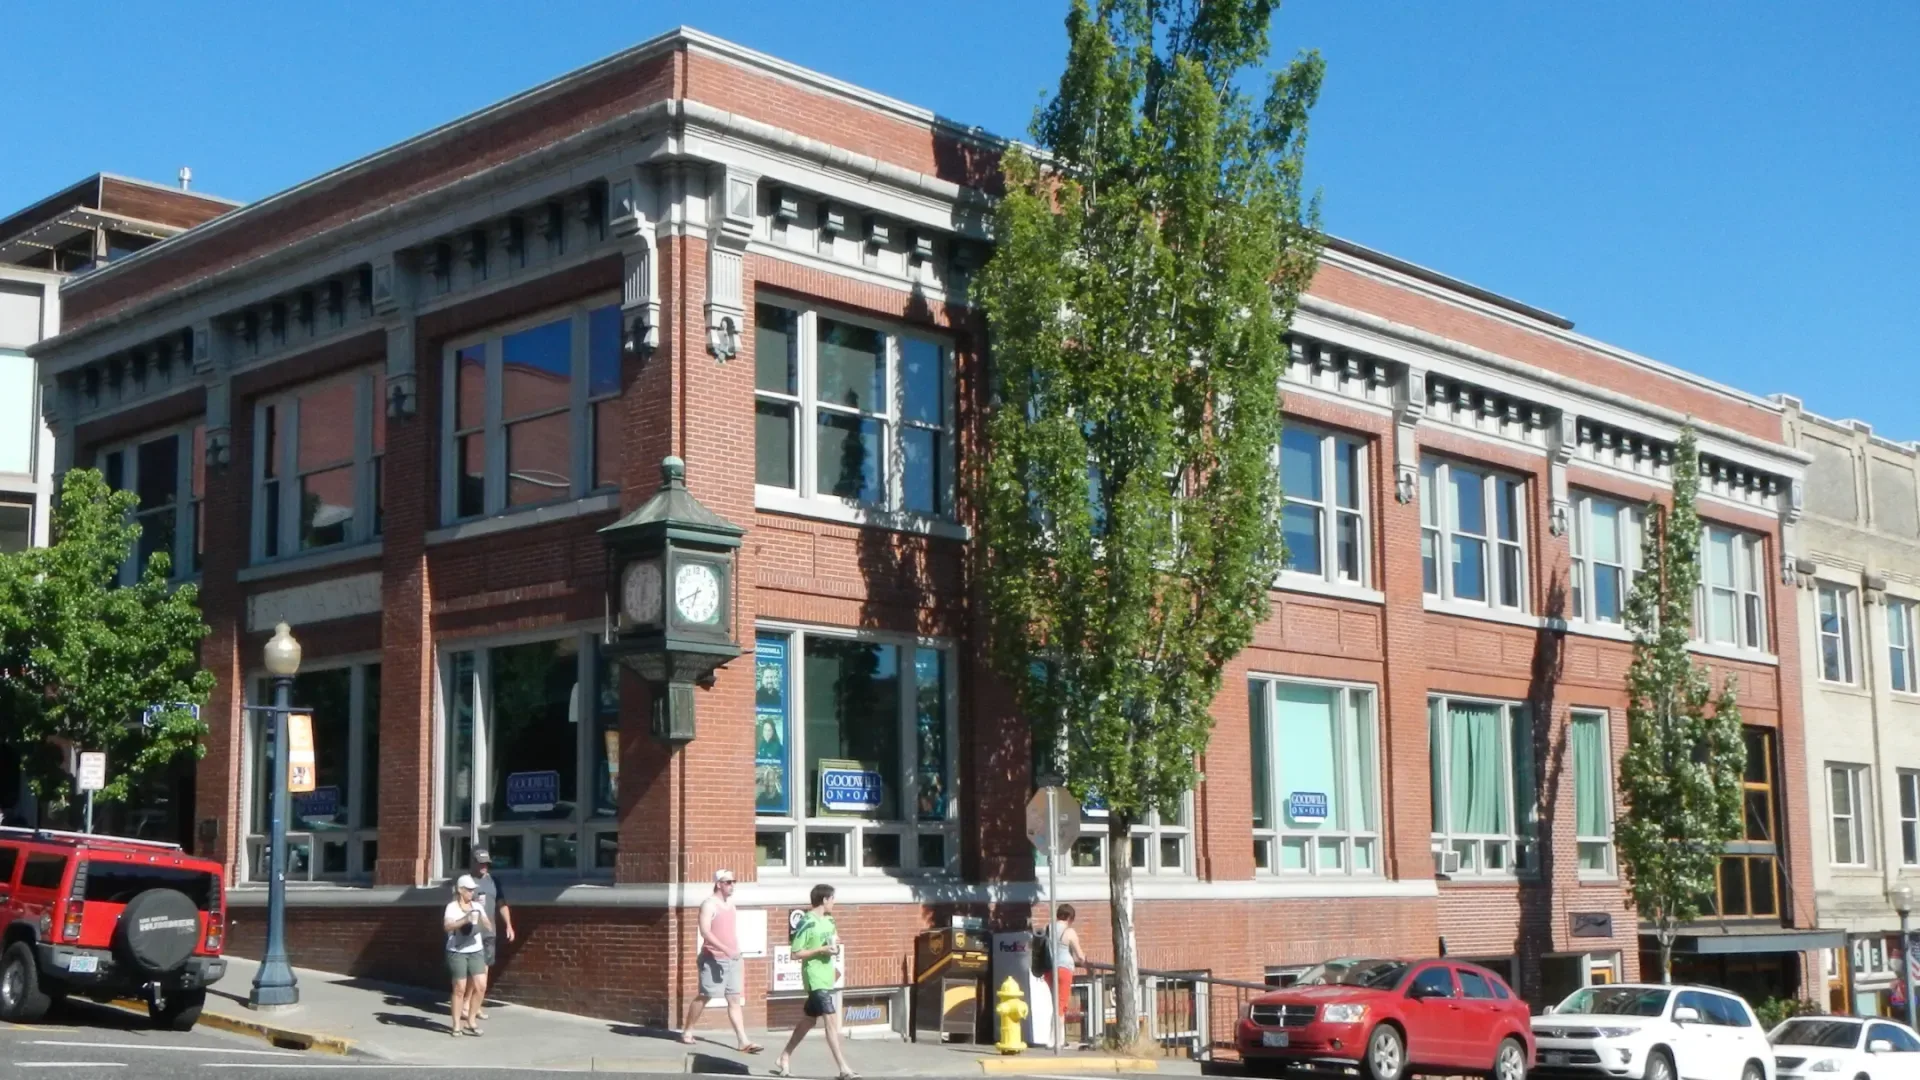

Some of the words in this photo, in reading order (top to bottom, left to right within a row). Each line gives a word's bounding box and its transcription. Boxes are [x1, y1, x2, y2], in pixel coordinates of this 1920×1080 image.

[826, 774, 877, 788] GOODWILL
[826, 790, 843, 799] ON
[853, 791, 877, 801] OAK
[1292, 794, 1325, 804] GOODWILL
[1000, 941, 1026, 953] FedEx
